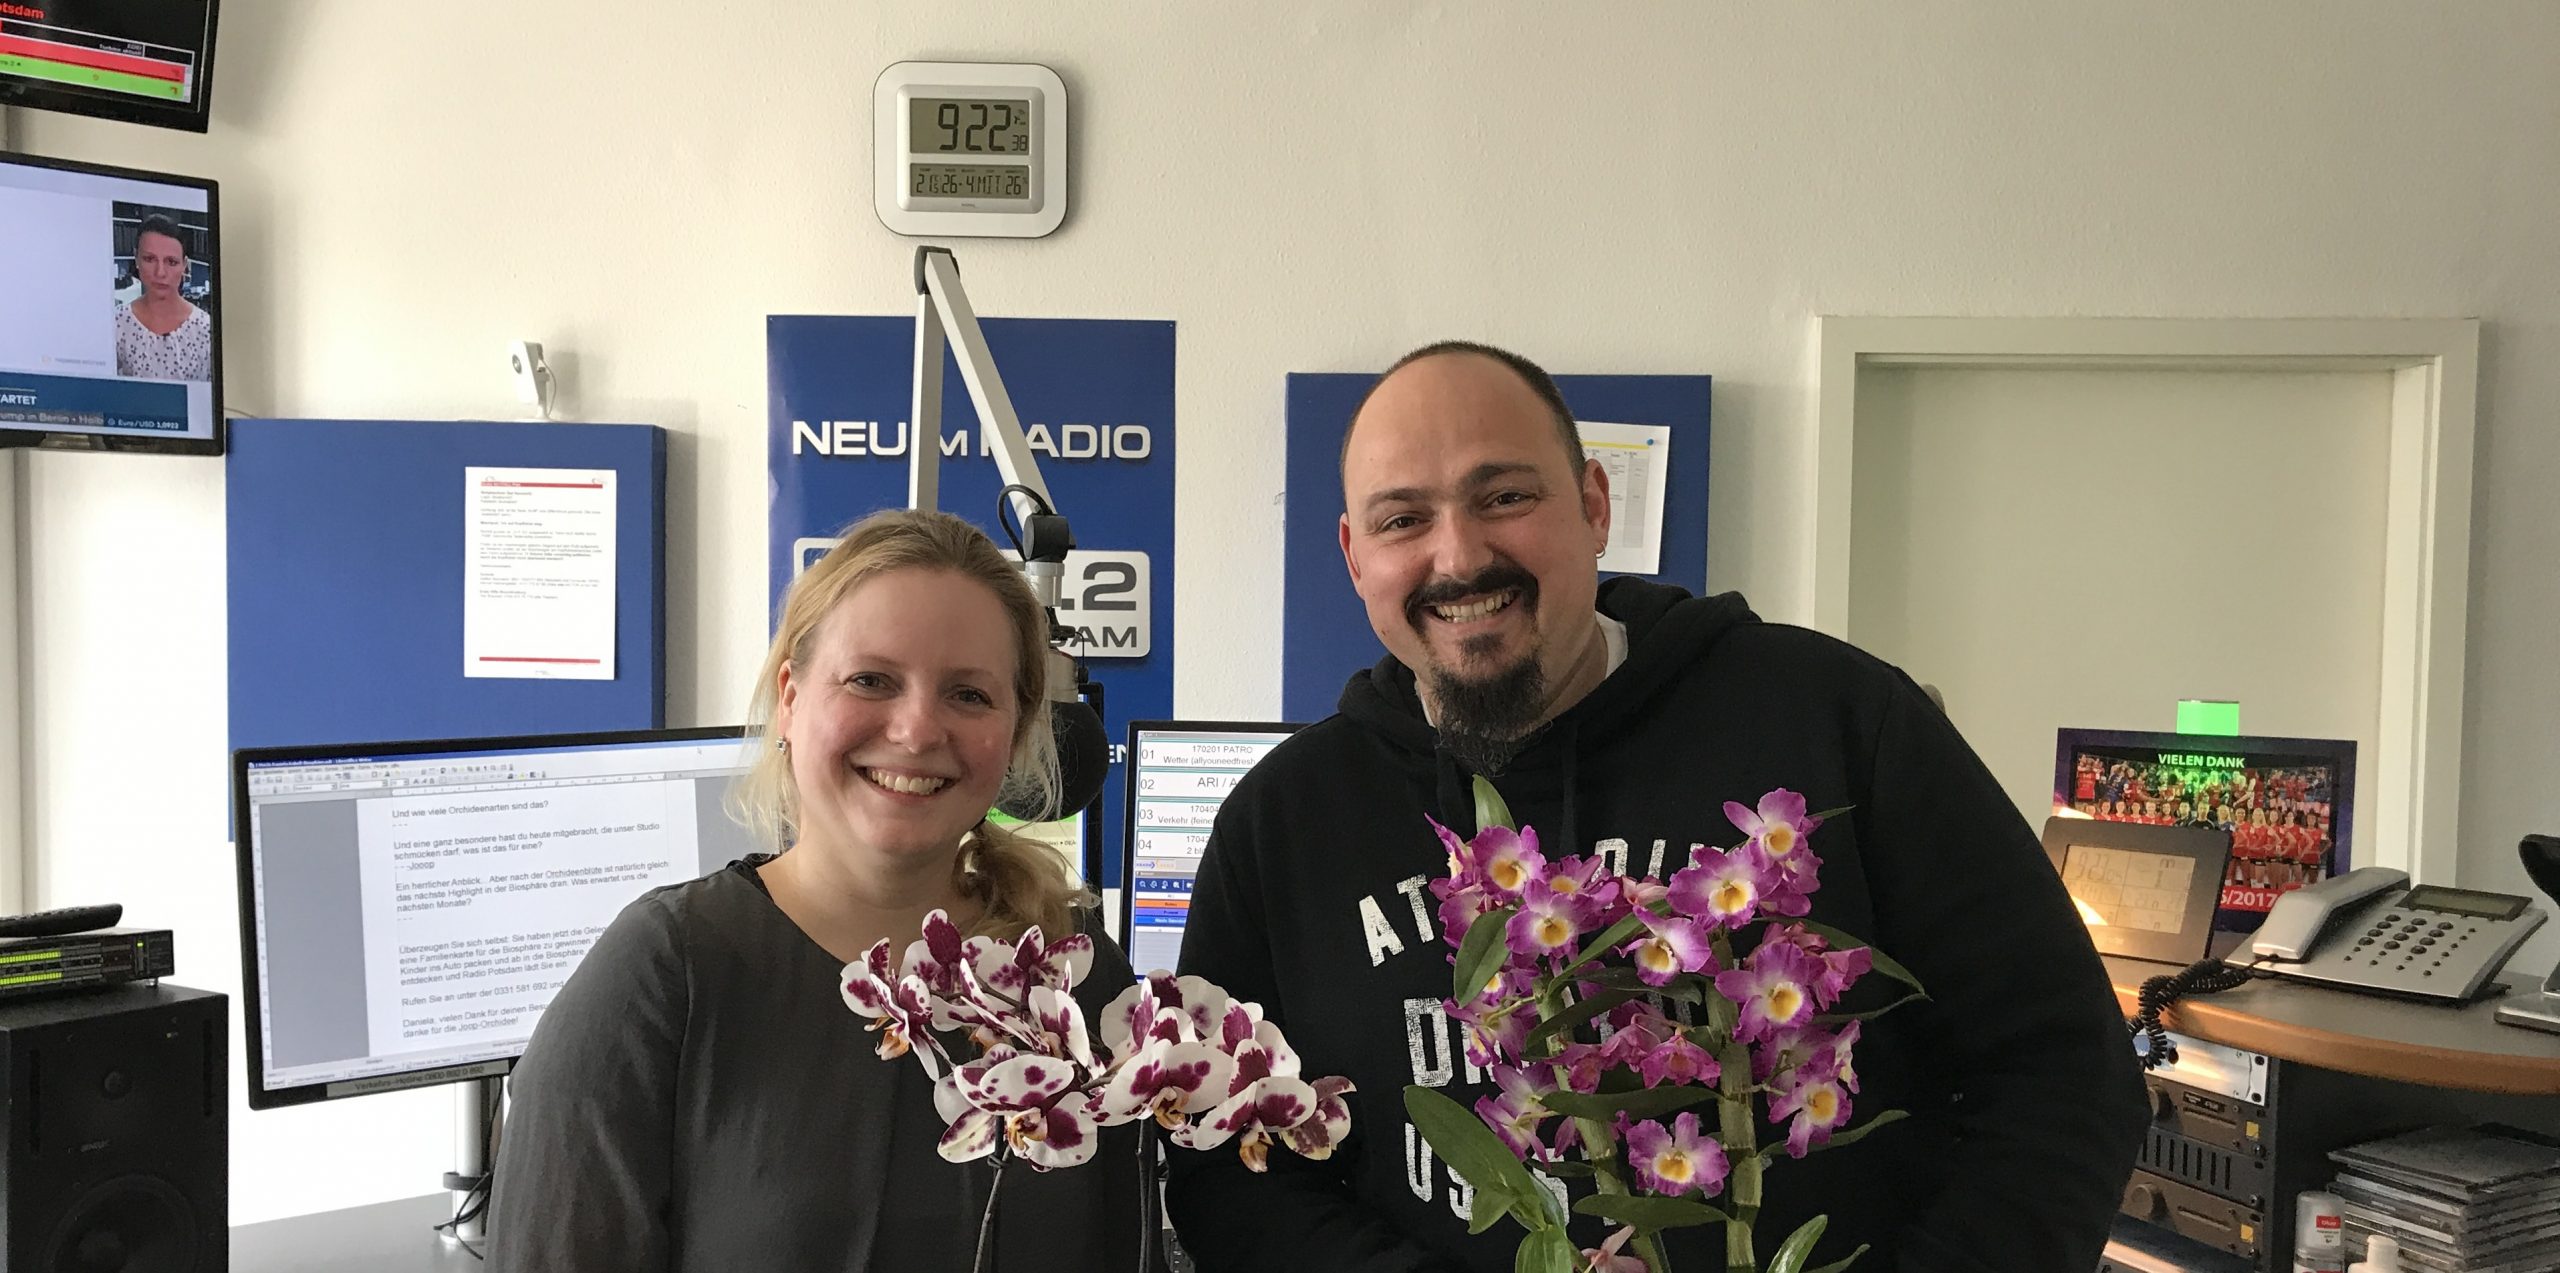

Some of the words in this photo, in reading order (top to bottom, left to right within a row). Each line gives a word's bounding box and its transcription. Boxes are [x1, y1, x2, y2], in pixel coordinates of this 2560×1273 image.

[1012, 134, 1028, 151] 38
[1005, 175, 1022, 195] 26
[939, 430, 968, 456] M
[980, 424, 1151, 459] ADIO
[1050, 626, 1137, 648] AM
[1141, 749, 1154, 759] 01
[1192, 745, 1220, 753] 170201
[1223, 746, 1253, 754] PATRO
[2158, 753, 2203, 767] VIELEN
[2206, 755, 2246, 769] DANK
[1140, 779, 1155, 789] 02
[1197, 777, 1219, 787] ARI
[1229, 778, 1238, 788] A
[392, 810, 410, 818] Und
[411, 809, 425, 817] wie
[428, 808, 446, 816] viele
[448, 804, 509, 814] Orchideenarten
[511, 802, 528, 810] sind
[530, 800, 549, 809] das?
[1139, 809, 1153, 820] 03
[1158, 816, 1188, 824] Verkehr
[1190, 816, 1214, 825] (feine
[393, 841, 411, 850] Und
[433, 840, 452, 849] ganz
[454, 835, 497, 846] besondere
[498, 834, 515, 842] hast
[529, 831, 551, 839] heute
[553, 827, 599, 838] mitgebracht,
[601, 826, 612, 834] die
[614, 825, 635, 833] unser
[636, 823, 660, 831] Studio
[1138, 839, 1152, 850] 04
[394, 849, 440, 860] schmücken
[463, 847, 480, 855] was
[481, 846, 491, 854] ist
[492, 845, 507, 853] das
[508, 843, 519, 851] für
[521, 841, 543, 850] eine?
[396, 882, 410, 891] Ein
[411, 879, 451, 889] herrlicher
[489, 874, 508, 883] Aber
[510, 872, 529, 880] nach
[530, 872, 544, 880] der
[545, 866, 602, 878] Orchideenblüte
[604, 865, 613, 873] ist
[614, 862, 646, 872] natürlich
[647, 860, 669, 871] gleich
[396, 893, 412, 902] das
[414, 890, 446, 900] nächste
[448, 886, 483, 898] Highlight
[485, 886, 492, 894] in
[494, 885, 507, 893] der
[508, 880, 548, 892] Biosphäre
[571, 878, 589, 886] Was
[590, 875, 620, 884] erwartet
[637, 872, 648, 880] die
[397, 903, 434, 912] nächsten
[436, 898, 472, 908] Monate?
[399, 942, 449, 954] Überzeugen
[450, 940, 465, 949] Sie
[467, 939, 482, 947] sich
[512, 934, 525, 942] Sie
[527, 932, 551, 940] haben
[552, 930, 569, 940] jetzt
[570, 929, 582, 937] die
[584, 926, 607, 936] Geleg
[400, 957, 417, 965] eine
[420, 951, 474, 962] Familienkarte
[476, 948, 486, 956] für
[502, 943, 541, 954] Biosphäre
[400, 966, 427, 975] Kinder
[429, 964, 441, 972] ins
[443, 962, 461, 971] Auto
[464, 959, 492, 969] packen
[494, 957, 509, 965] und
[532, 952, 544, 960] die
[401, 975, 443, 986] entdecken
[445, 972, 460, 981] und
[462, 970, 486, 979] Radio
[488, 965, 523, 976] Potsdam
[524, 963, 539, 971] lädt
[541, 961, 553, 969] Sie
[401, 998, 427, 1006] Rufen
[429, 995, 442, 1003] Sie
[457, 991, 477, 1000] unter
[479, 989, 492, 998] der
[494, 986, 514, 995] 0331
[516, 984, 530, 992] 581
[439, 1013, 463, 1022] vielen
[465, 1010, 486, 1019] Dank
[487, 1008, 498, 1017] für
[501, 1006, 526, 1015] deinen
[529, 1003, 548, 1012] Besu
[403, 1028, 428, 1038] danke
[431, 1026, 442, 1034] für
[444, 1024, 456, 1032] die
